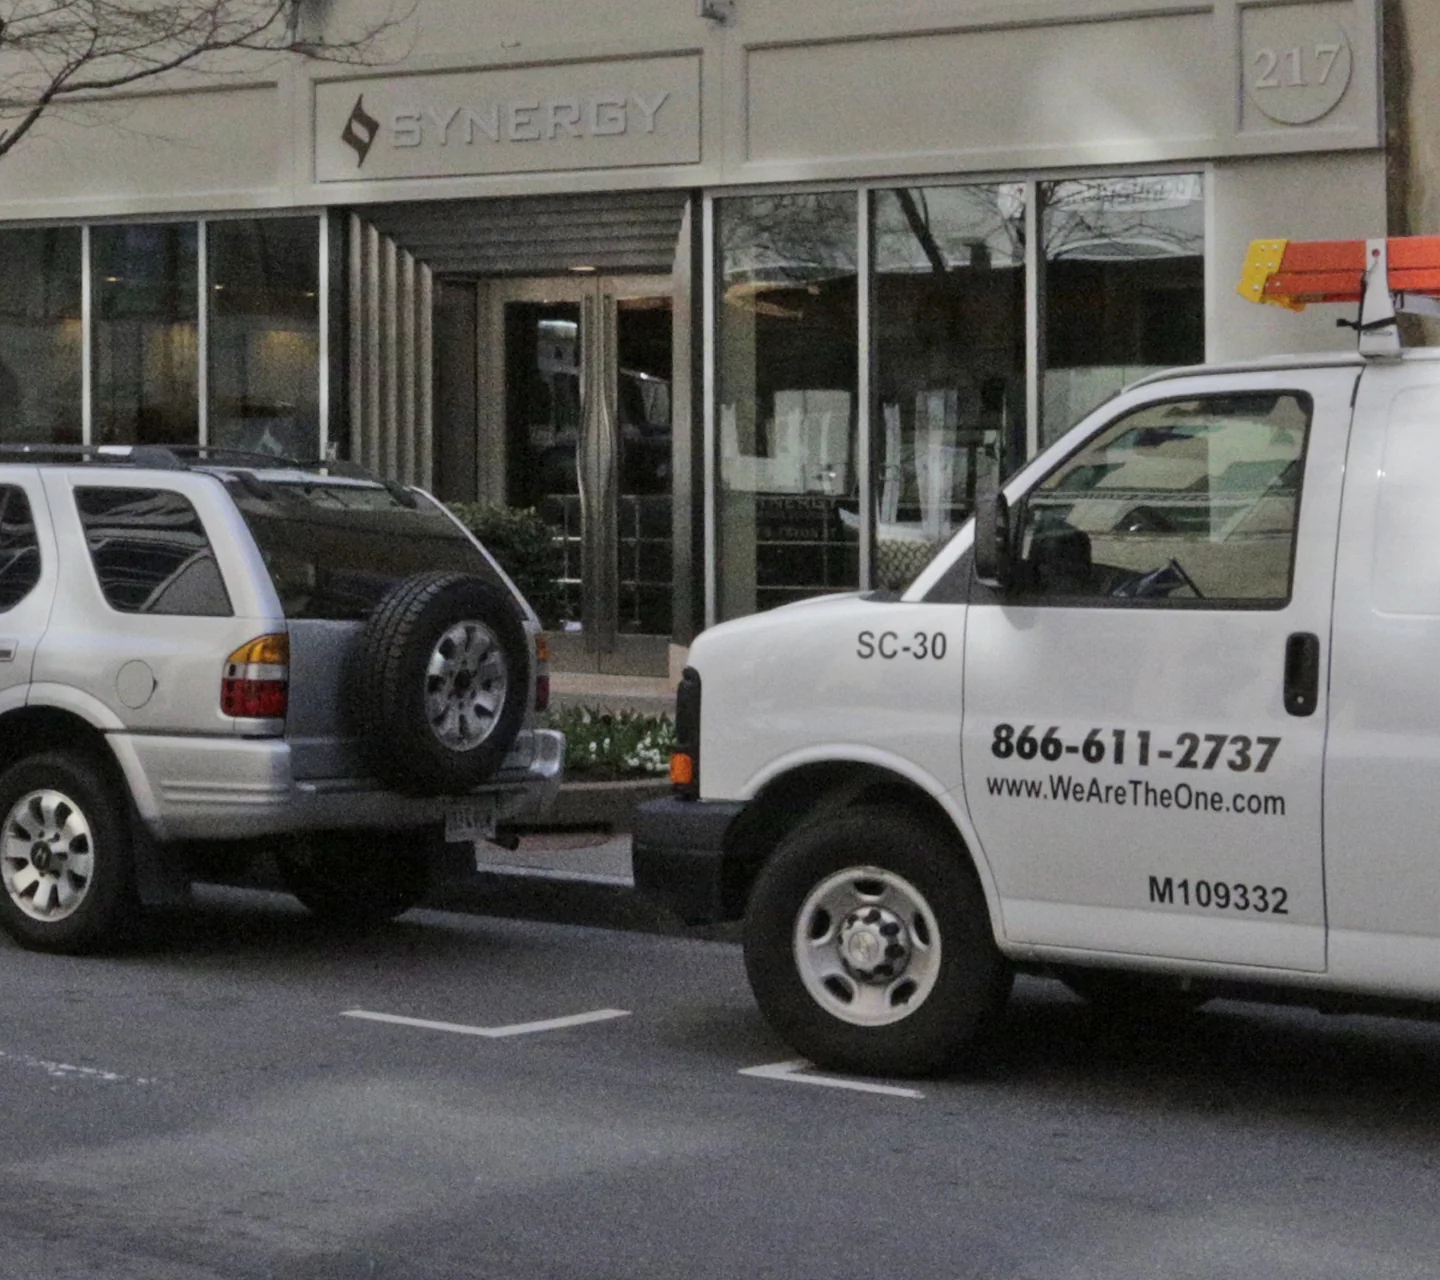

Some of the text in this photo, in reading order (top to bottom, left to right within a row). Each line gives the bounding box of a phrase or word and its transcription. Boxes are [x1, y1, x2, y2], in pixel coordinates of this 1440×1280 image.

[1253, 43, 1342, 90] 217
[390, 92, 671, 149] SYNERGY
[856, 632, 948, 660] SC-30
[991, 723, 1283, 773] 866-611-2737
[987, 774, 1287, 816] www.WeAreTheOne.com
[1148, 875, 1289, 915] M109332
